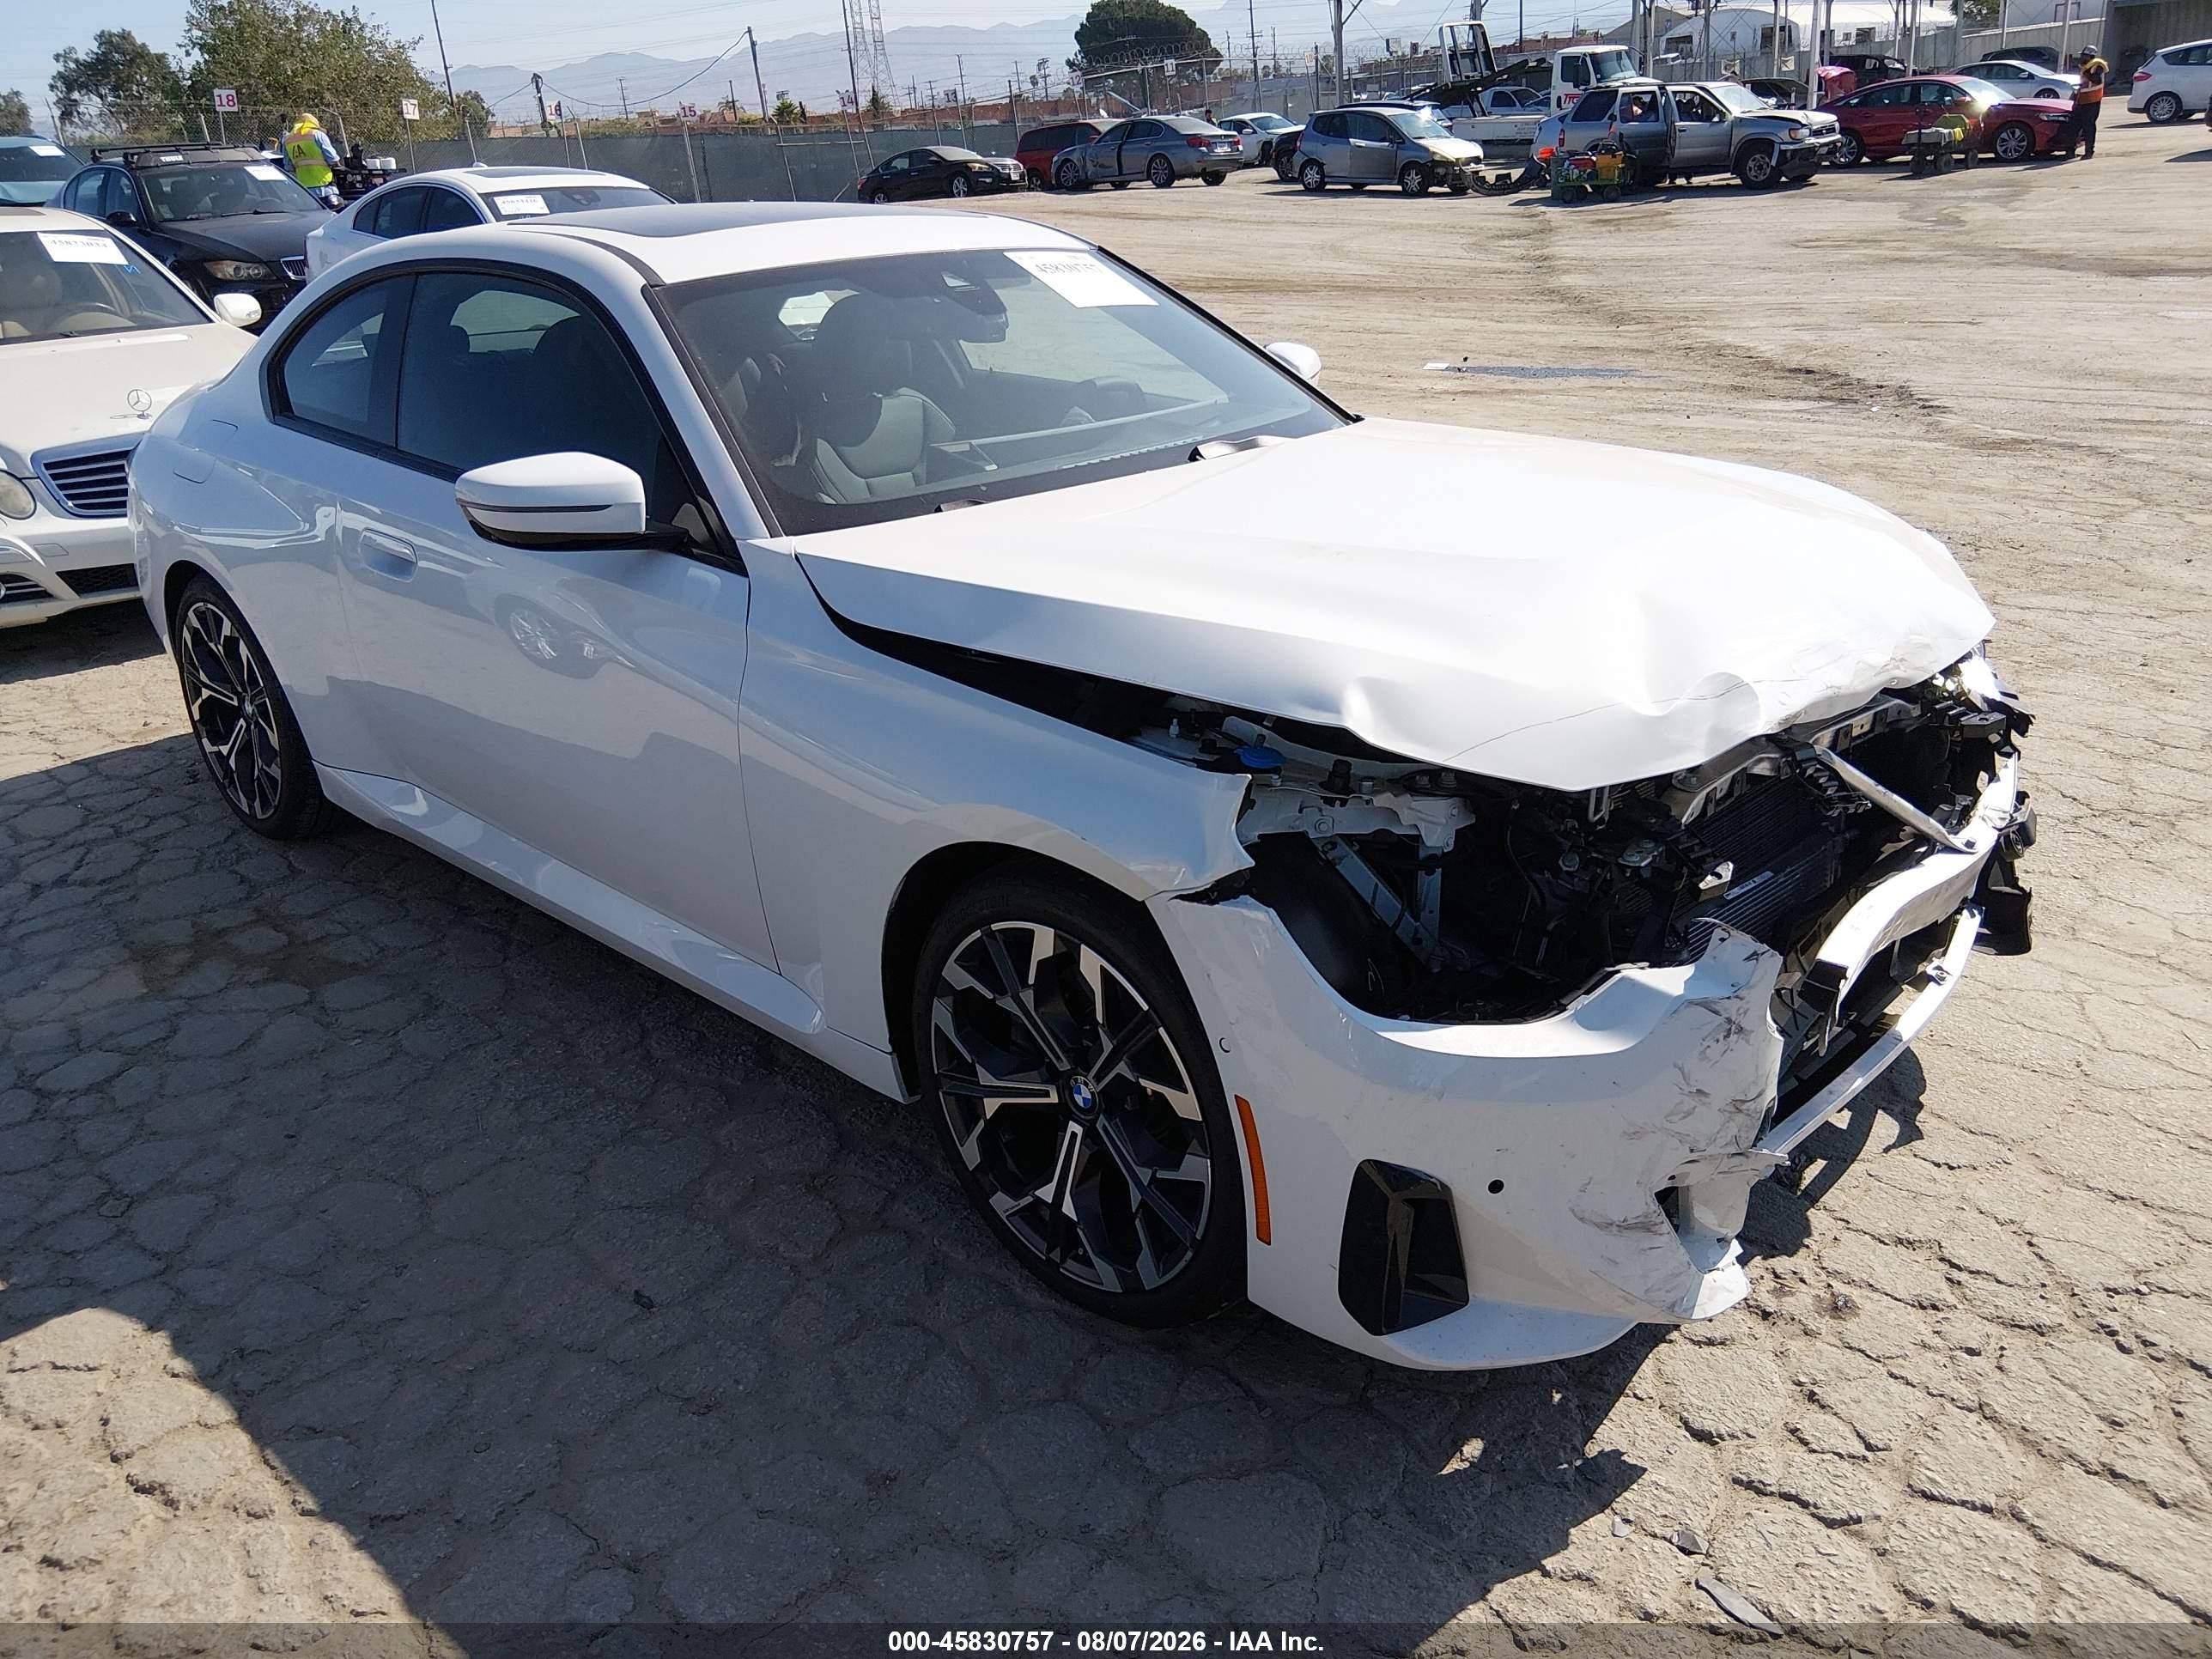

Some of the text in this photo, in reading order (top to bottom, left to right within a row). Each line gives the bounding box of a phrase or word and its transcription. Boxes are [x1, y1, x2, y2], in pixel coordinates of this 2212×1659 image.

[1070, 75, 1082, 86] 12
[216, 94, 236, 107] 18
[839, 94, 854, 107] 14
[404, 102, 416, 116] 17
[680, 106, 696, 118] 15
